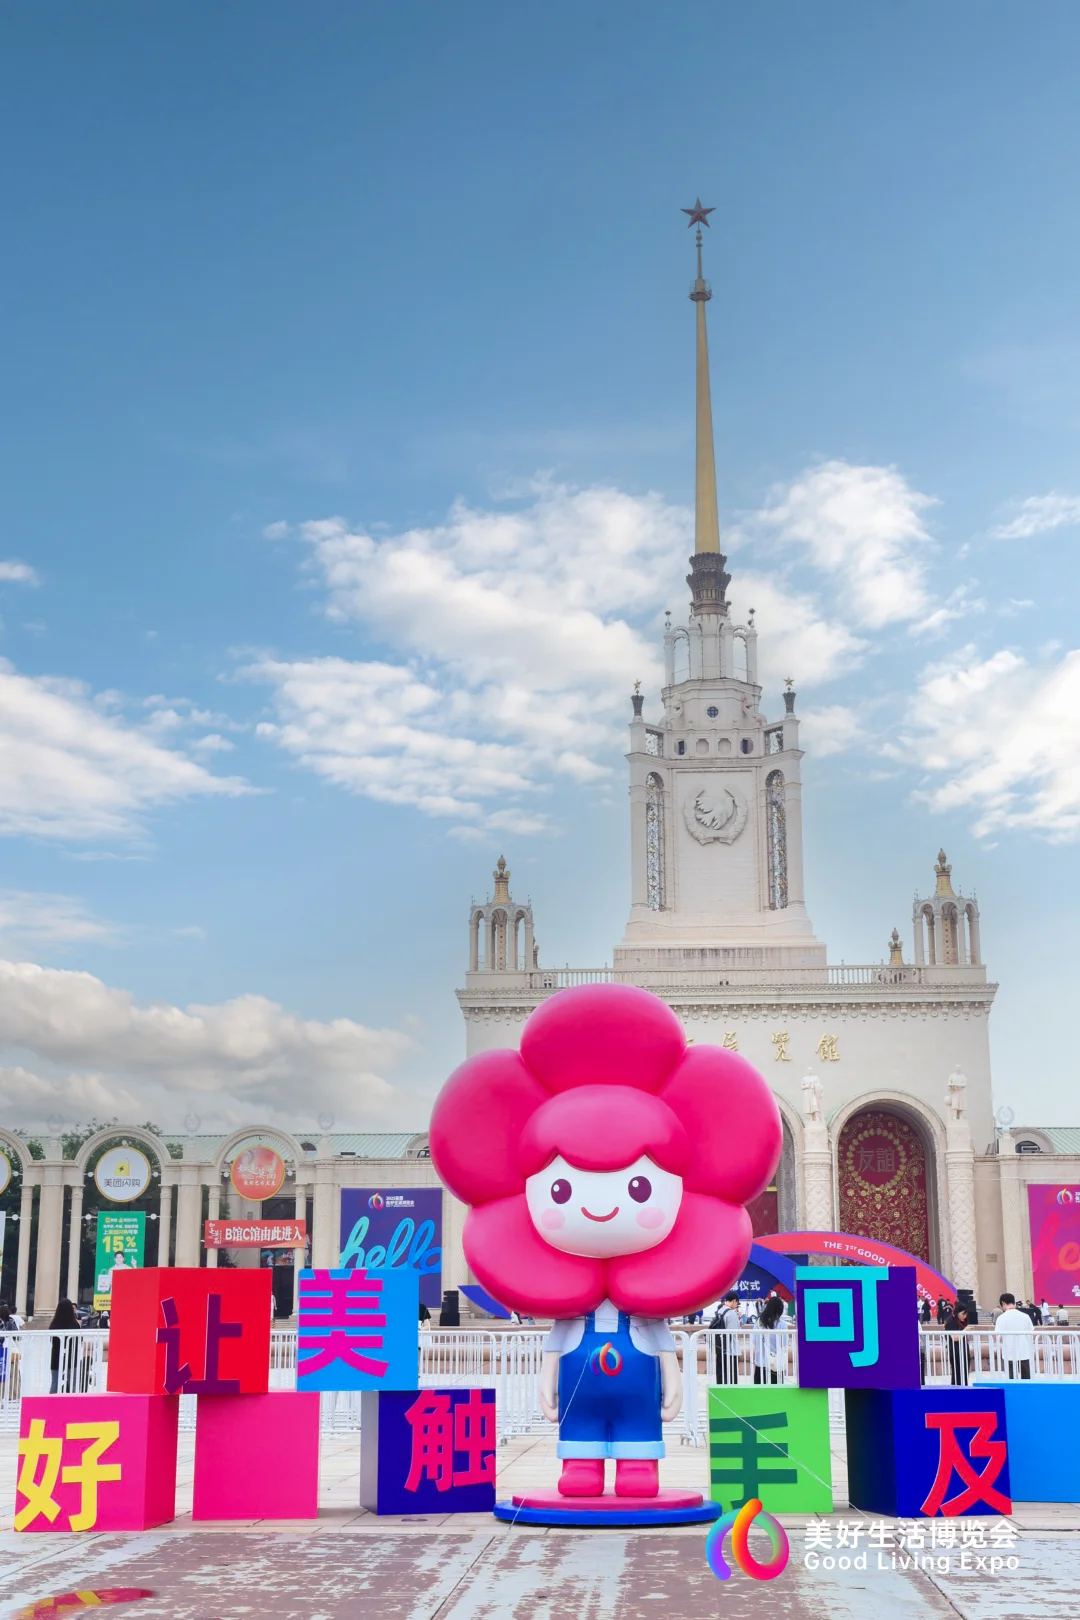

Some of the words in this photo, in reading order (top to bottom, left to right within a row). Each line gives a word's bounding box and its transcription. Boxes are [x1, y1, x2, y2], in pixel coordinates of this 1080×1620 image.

[104, 1179, 140, 1187] 美团闪购
[857, 1147, 896, 1172] 友誼
[225, 1226, 302, 1241] B馆C馆由此进入
[823, 1241, 843, 1250] THE
[857, 1248, 885, 1264] GOOD
[156, 1294, 242, 1394] 让
[298, 1269, 389, 1377] 美
[796, 1266, 889, 1367] 可
[916, 1283, 936, 1307] EXPO
[14, 1419, 121, 1531] 好
[404, 1389, 496, 1493] 触
[710, 1412, 797, 1511] 手
[920, 1412, 1013, 1517] 及
